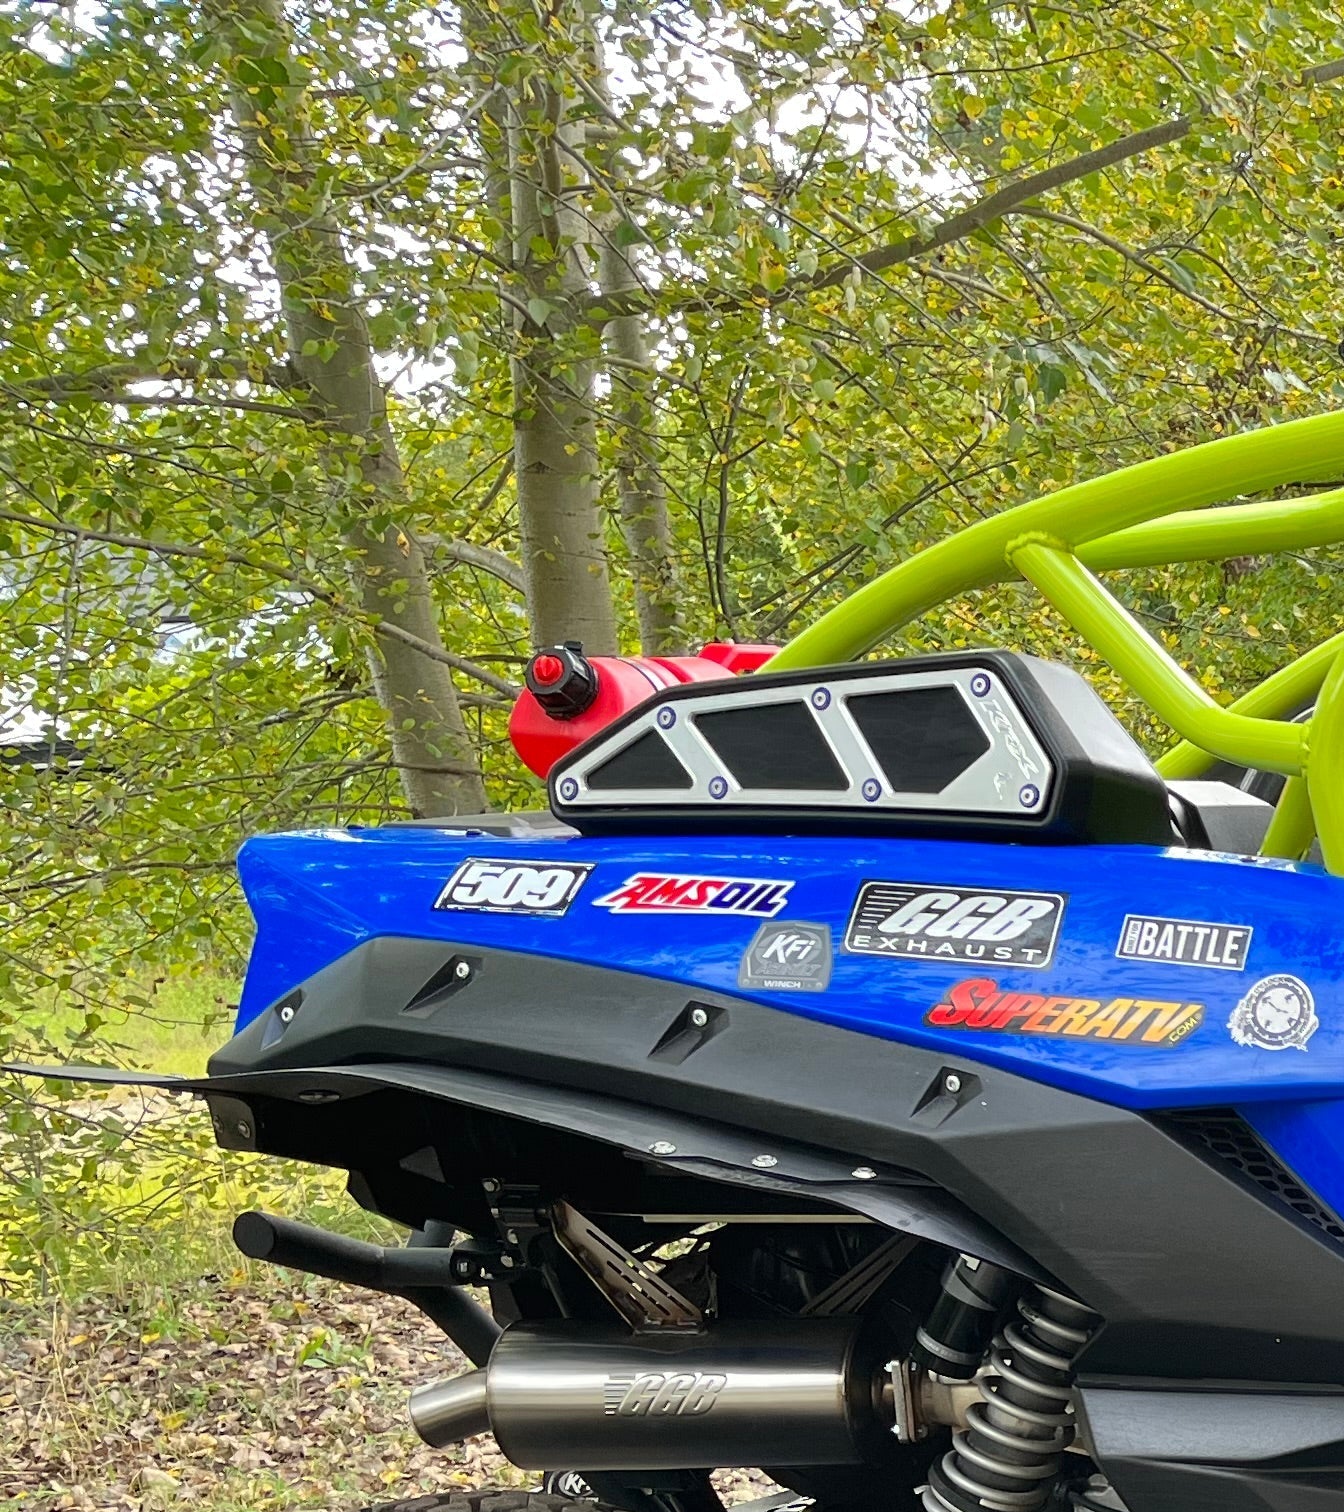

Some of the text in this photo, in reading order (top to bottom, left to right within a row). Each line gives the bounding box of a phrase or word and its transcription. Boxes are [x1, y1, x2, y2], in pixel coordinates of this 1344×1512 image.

[452, 865, 576, 908] 509
[604, 876, 788, 914] AMSOIL
[878, 892, 1055, 942] GGB
[853, 935, 1042, 962] EXHAUST
[1137, 921, 1244, 965] BATTLE
[763, 980, 802, 989] WINCH
[619, 1373, 728, 1417] GGB
